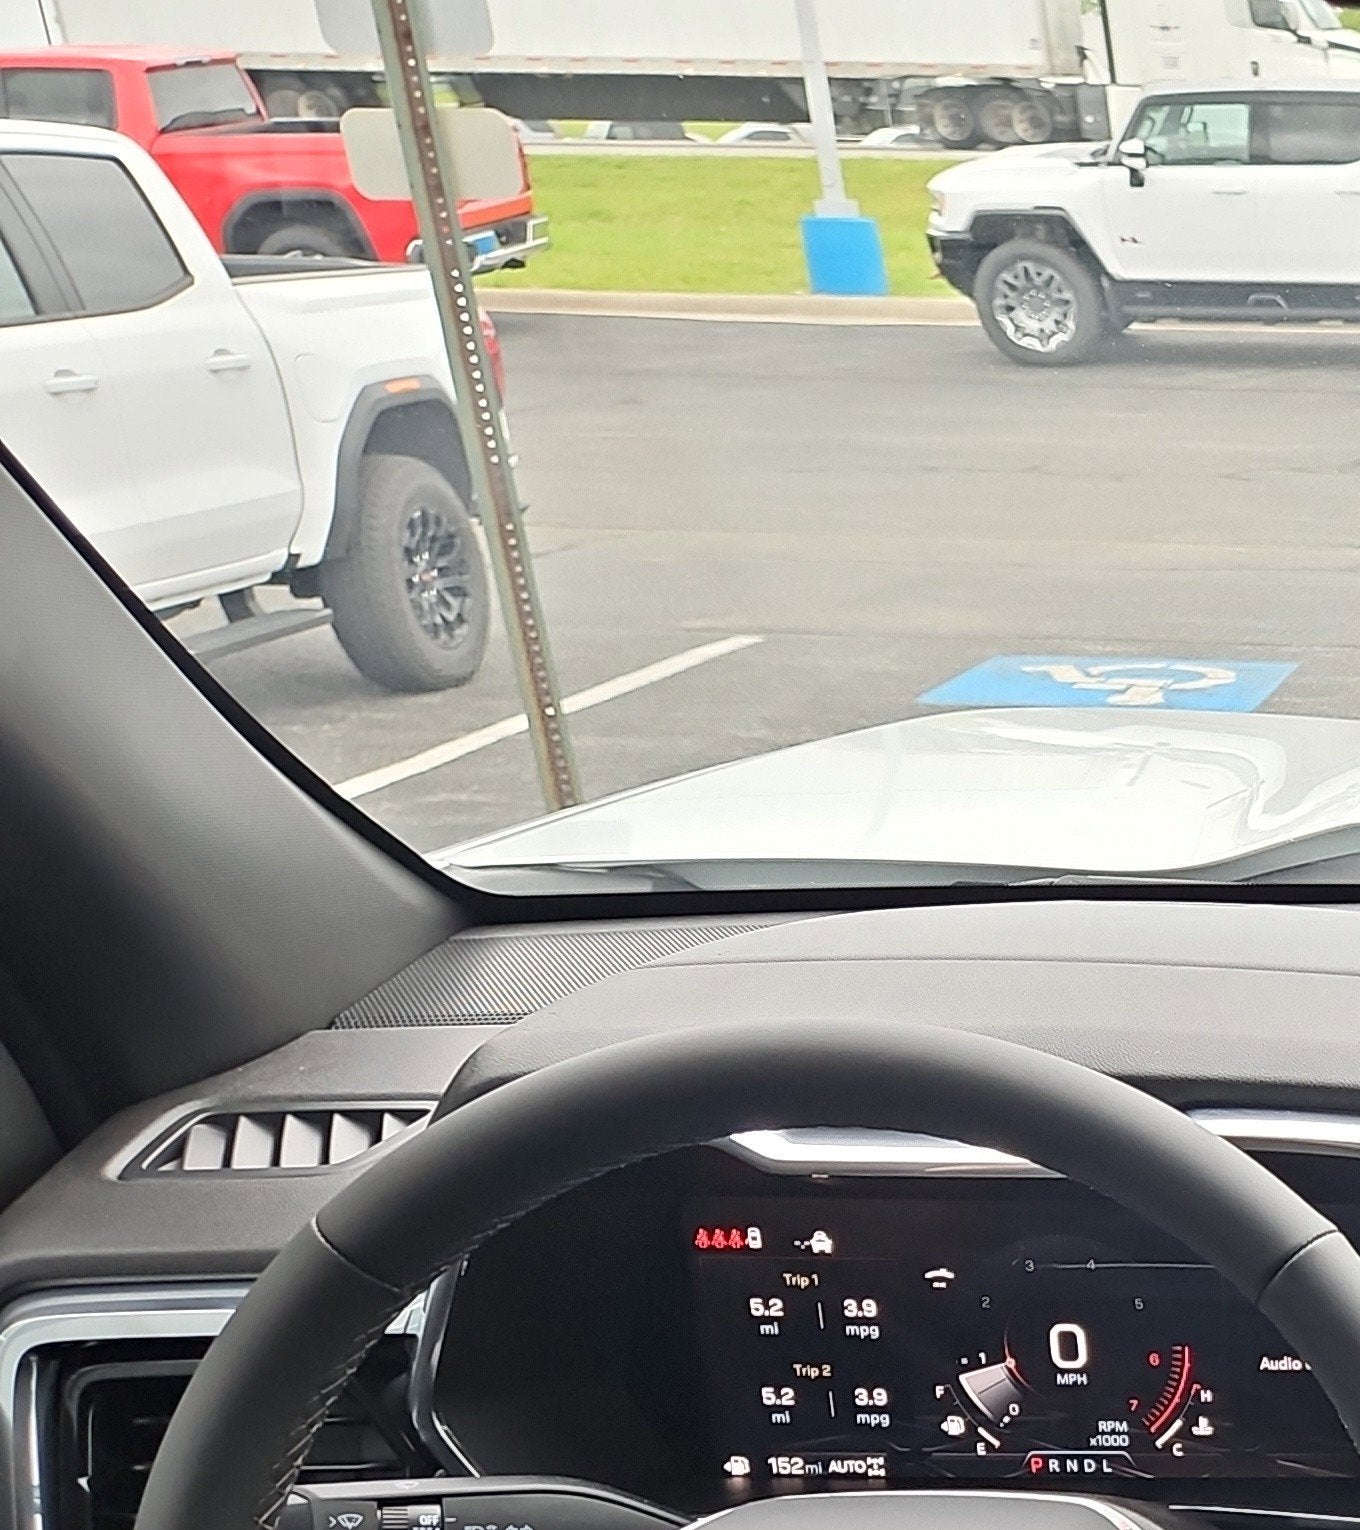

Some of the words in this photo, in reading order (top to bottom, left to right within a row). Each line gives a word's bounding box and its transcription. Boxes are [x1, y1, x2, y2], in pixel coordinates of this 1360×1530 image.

[1024, 1260, 1035, 1271] 3
[1086, 1259, 1096, 1270] 4
[782, 1273, 809, 1289] Trip
[812, 1274, 819, 1286] 1
[750, 1298, 784, 1317] 5.2
[843, 1298, 878, 1317] 3.9
[981, 1297, 991, 1309] 2
[1134, 1298, 1144, 1310] 5
[759, 1323, 779, 1335] mi
[845, 1324, 880, 1339] mpg
[1049, 1323, 1088, 1369] 0
[979, 1353, 986, 1364] 1
[1259, 1356, 1303, 1371] Audio
[793, 1364, 819, 1379] Trip
[822, 1364, 832, 1377] 2
[1056, 1373, 1088, 1386] MPH
[761, 1387, 795, 1406] 5.2
[854, 1388, 888, 1406] 3.9
[935, 1386, 945, 1398] F
[1200, 1390, 1213, 1402] H
[1009, 1404, 1020, 1416] 0
[1129, 1400, 1138, 1412] 7
[772, 1411, 790, 1423] mi
[856, 1413, 890, 1428] mpg
[1098, 1421, 1129, 1432] RPM
[1089, 1435, 1129, 1447] x1000
[976, 1443, 986, 1456] E
[1172, 1444, 1184, 1457] C
[829, 1460, 866, 1473] AUTO
[1030, 1458, 1042, 1473] P
[1049, 1459, 1060, 1472] R
[1066, 1459, 1078, 1472] N
[1084, 1459, 1096, 1472] D
[1102, 1459, 1112, 1472] L
[419, 1514, 439, 1526] OFF
